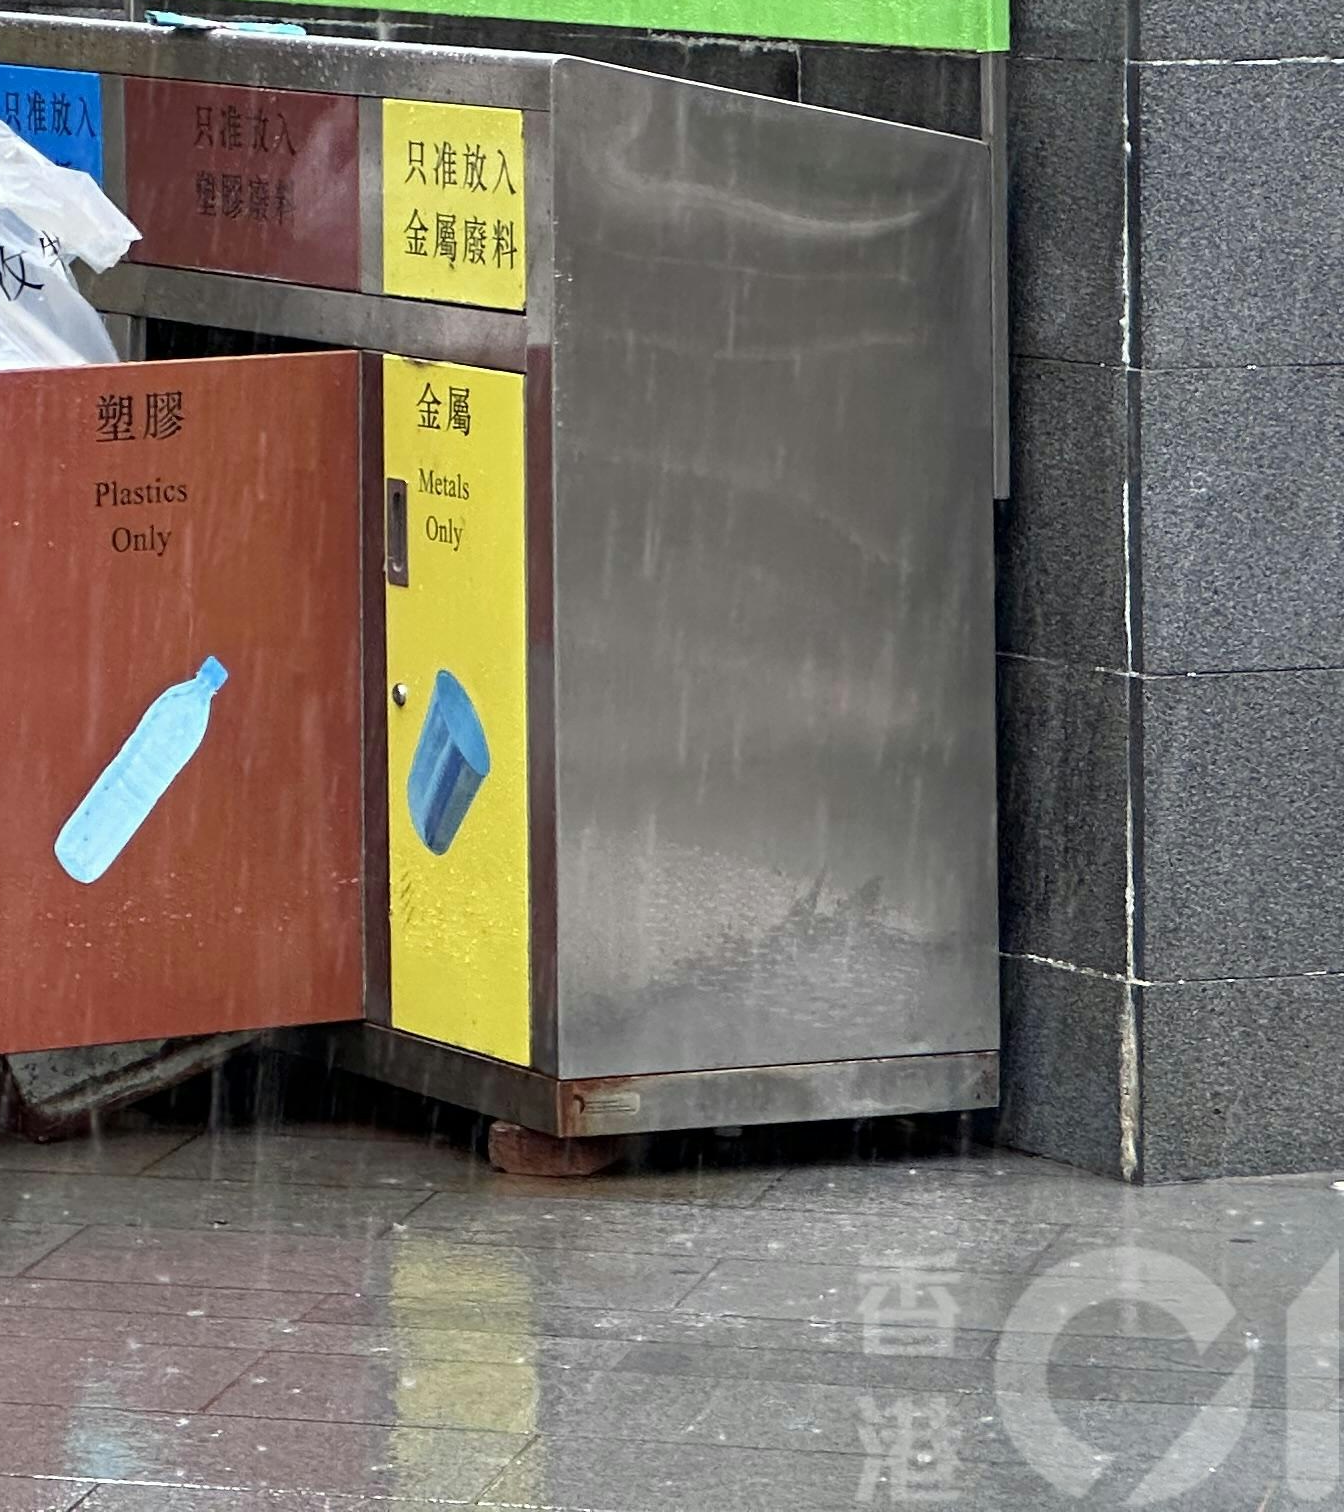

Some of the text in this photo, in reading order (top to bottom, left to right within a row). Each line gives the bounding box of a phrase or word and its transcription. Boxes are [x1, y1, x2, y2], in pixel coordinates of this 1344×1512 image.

[3, 90, 96, 138] 只准放入
[194, 106, 296, 157] 只准放入
[405, 140, 517, 196] 只准放入
[404, 208, 518, 270] 金屬廢料
[95, 391, 185, 443] 塑膠
[416, 382, 472, 437] 金屬
[94, 477, 189, 507] Plastics
[418, 467, 470, 501] Metals
[111, 524, 172, 557] Only
[425, 515, 465, 552] Only
